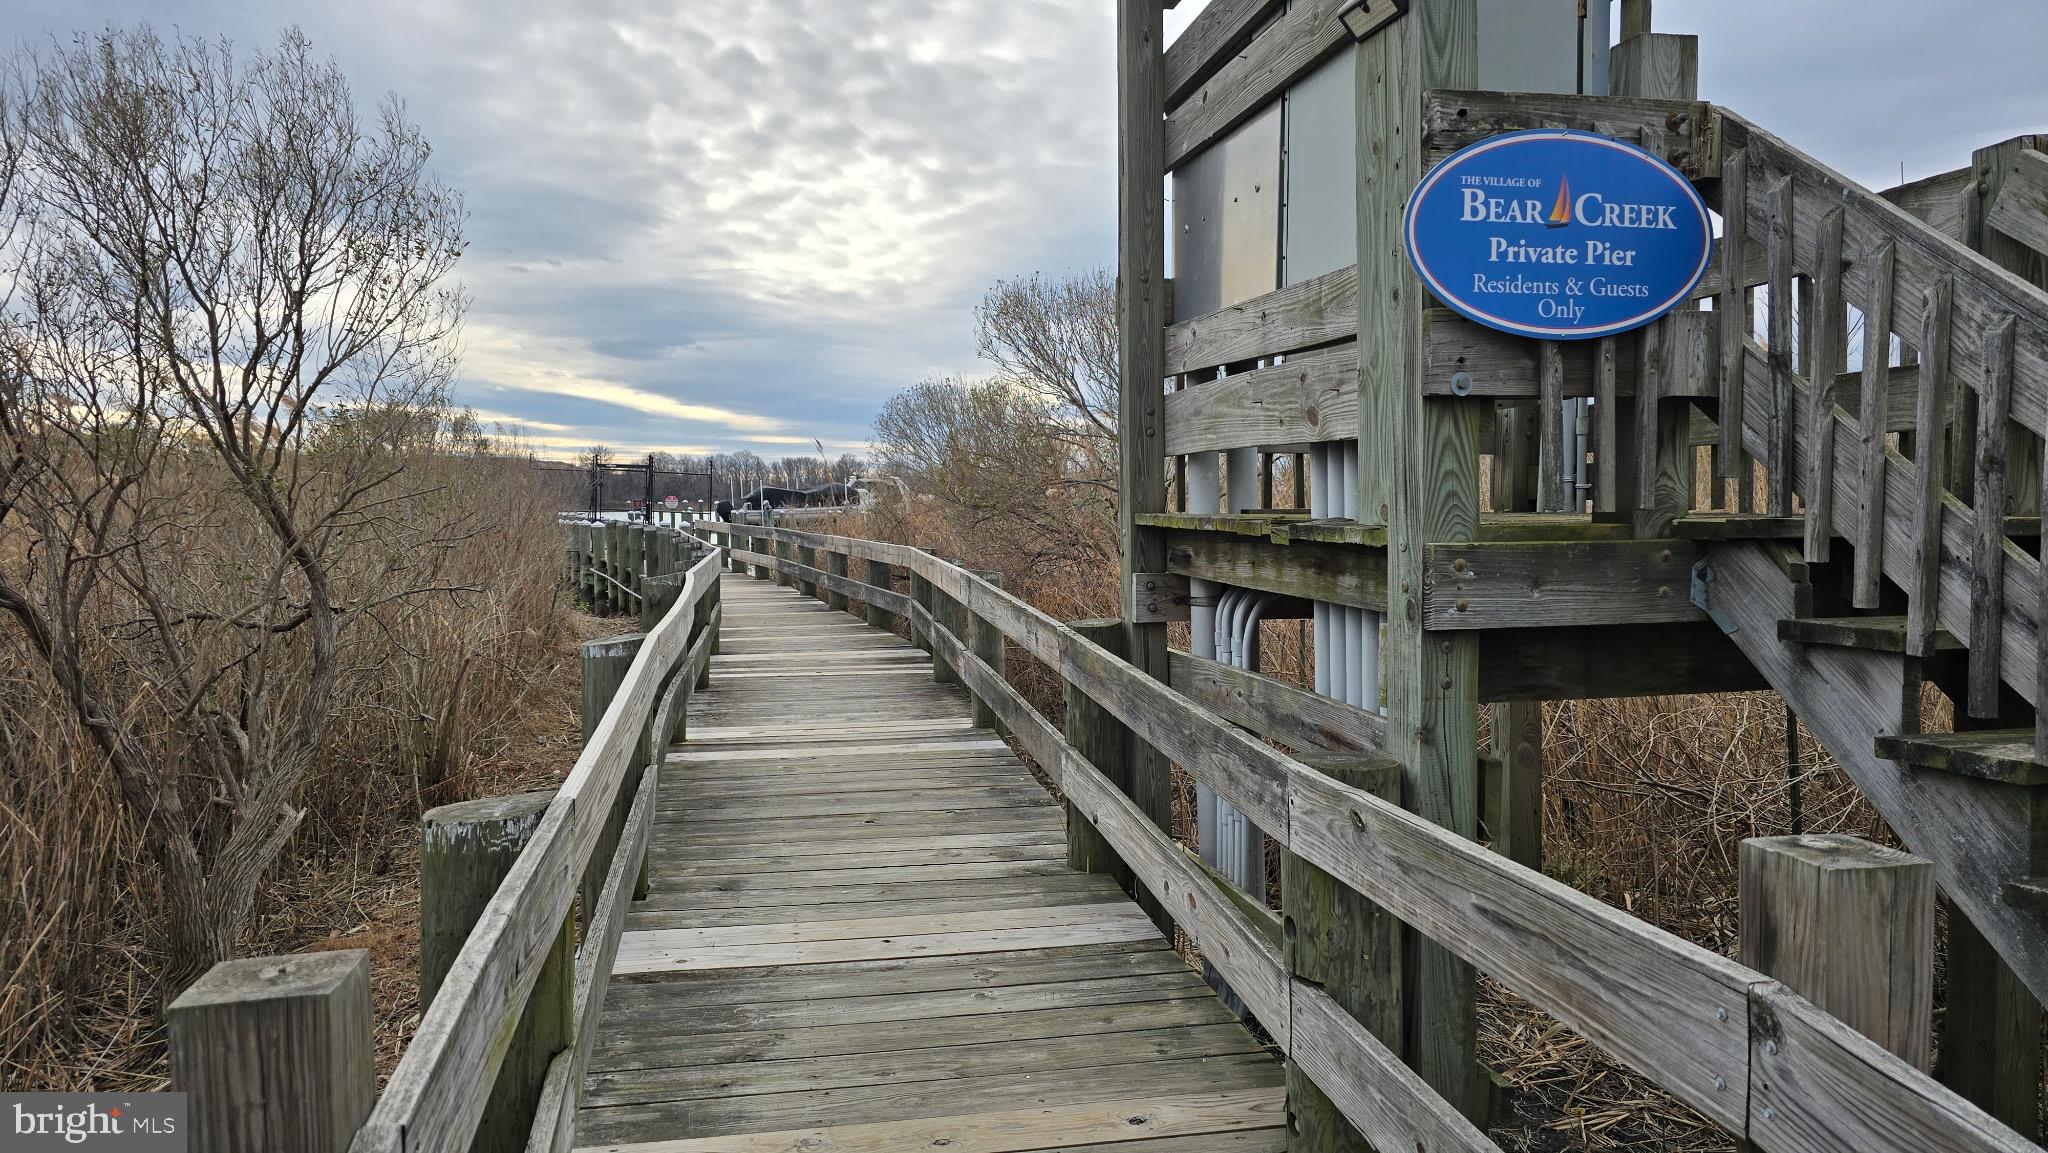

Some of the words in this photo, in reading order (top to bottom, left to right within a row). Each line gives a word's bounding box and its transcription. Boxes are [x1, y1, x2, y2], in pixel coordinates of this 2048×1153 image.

[1461, 176, 1481, 186] THE
[1484, 176, 1525, 187] VILLAGE
[1528, 178, 1541, 188] OF
[1460, 188, 1544, 224] BEAR
[1575, 193, 1677, 229] CREEK
[1489, 238, 1578, 264] Private
[1585, 241, 1636, 266] Pier
[1473, 274, 1559, 294] Residents
[1566, 278, 1583, 295] &
[1590, 279, 1649, 297] Guests
[1538, 299, 1585, 324] Only
